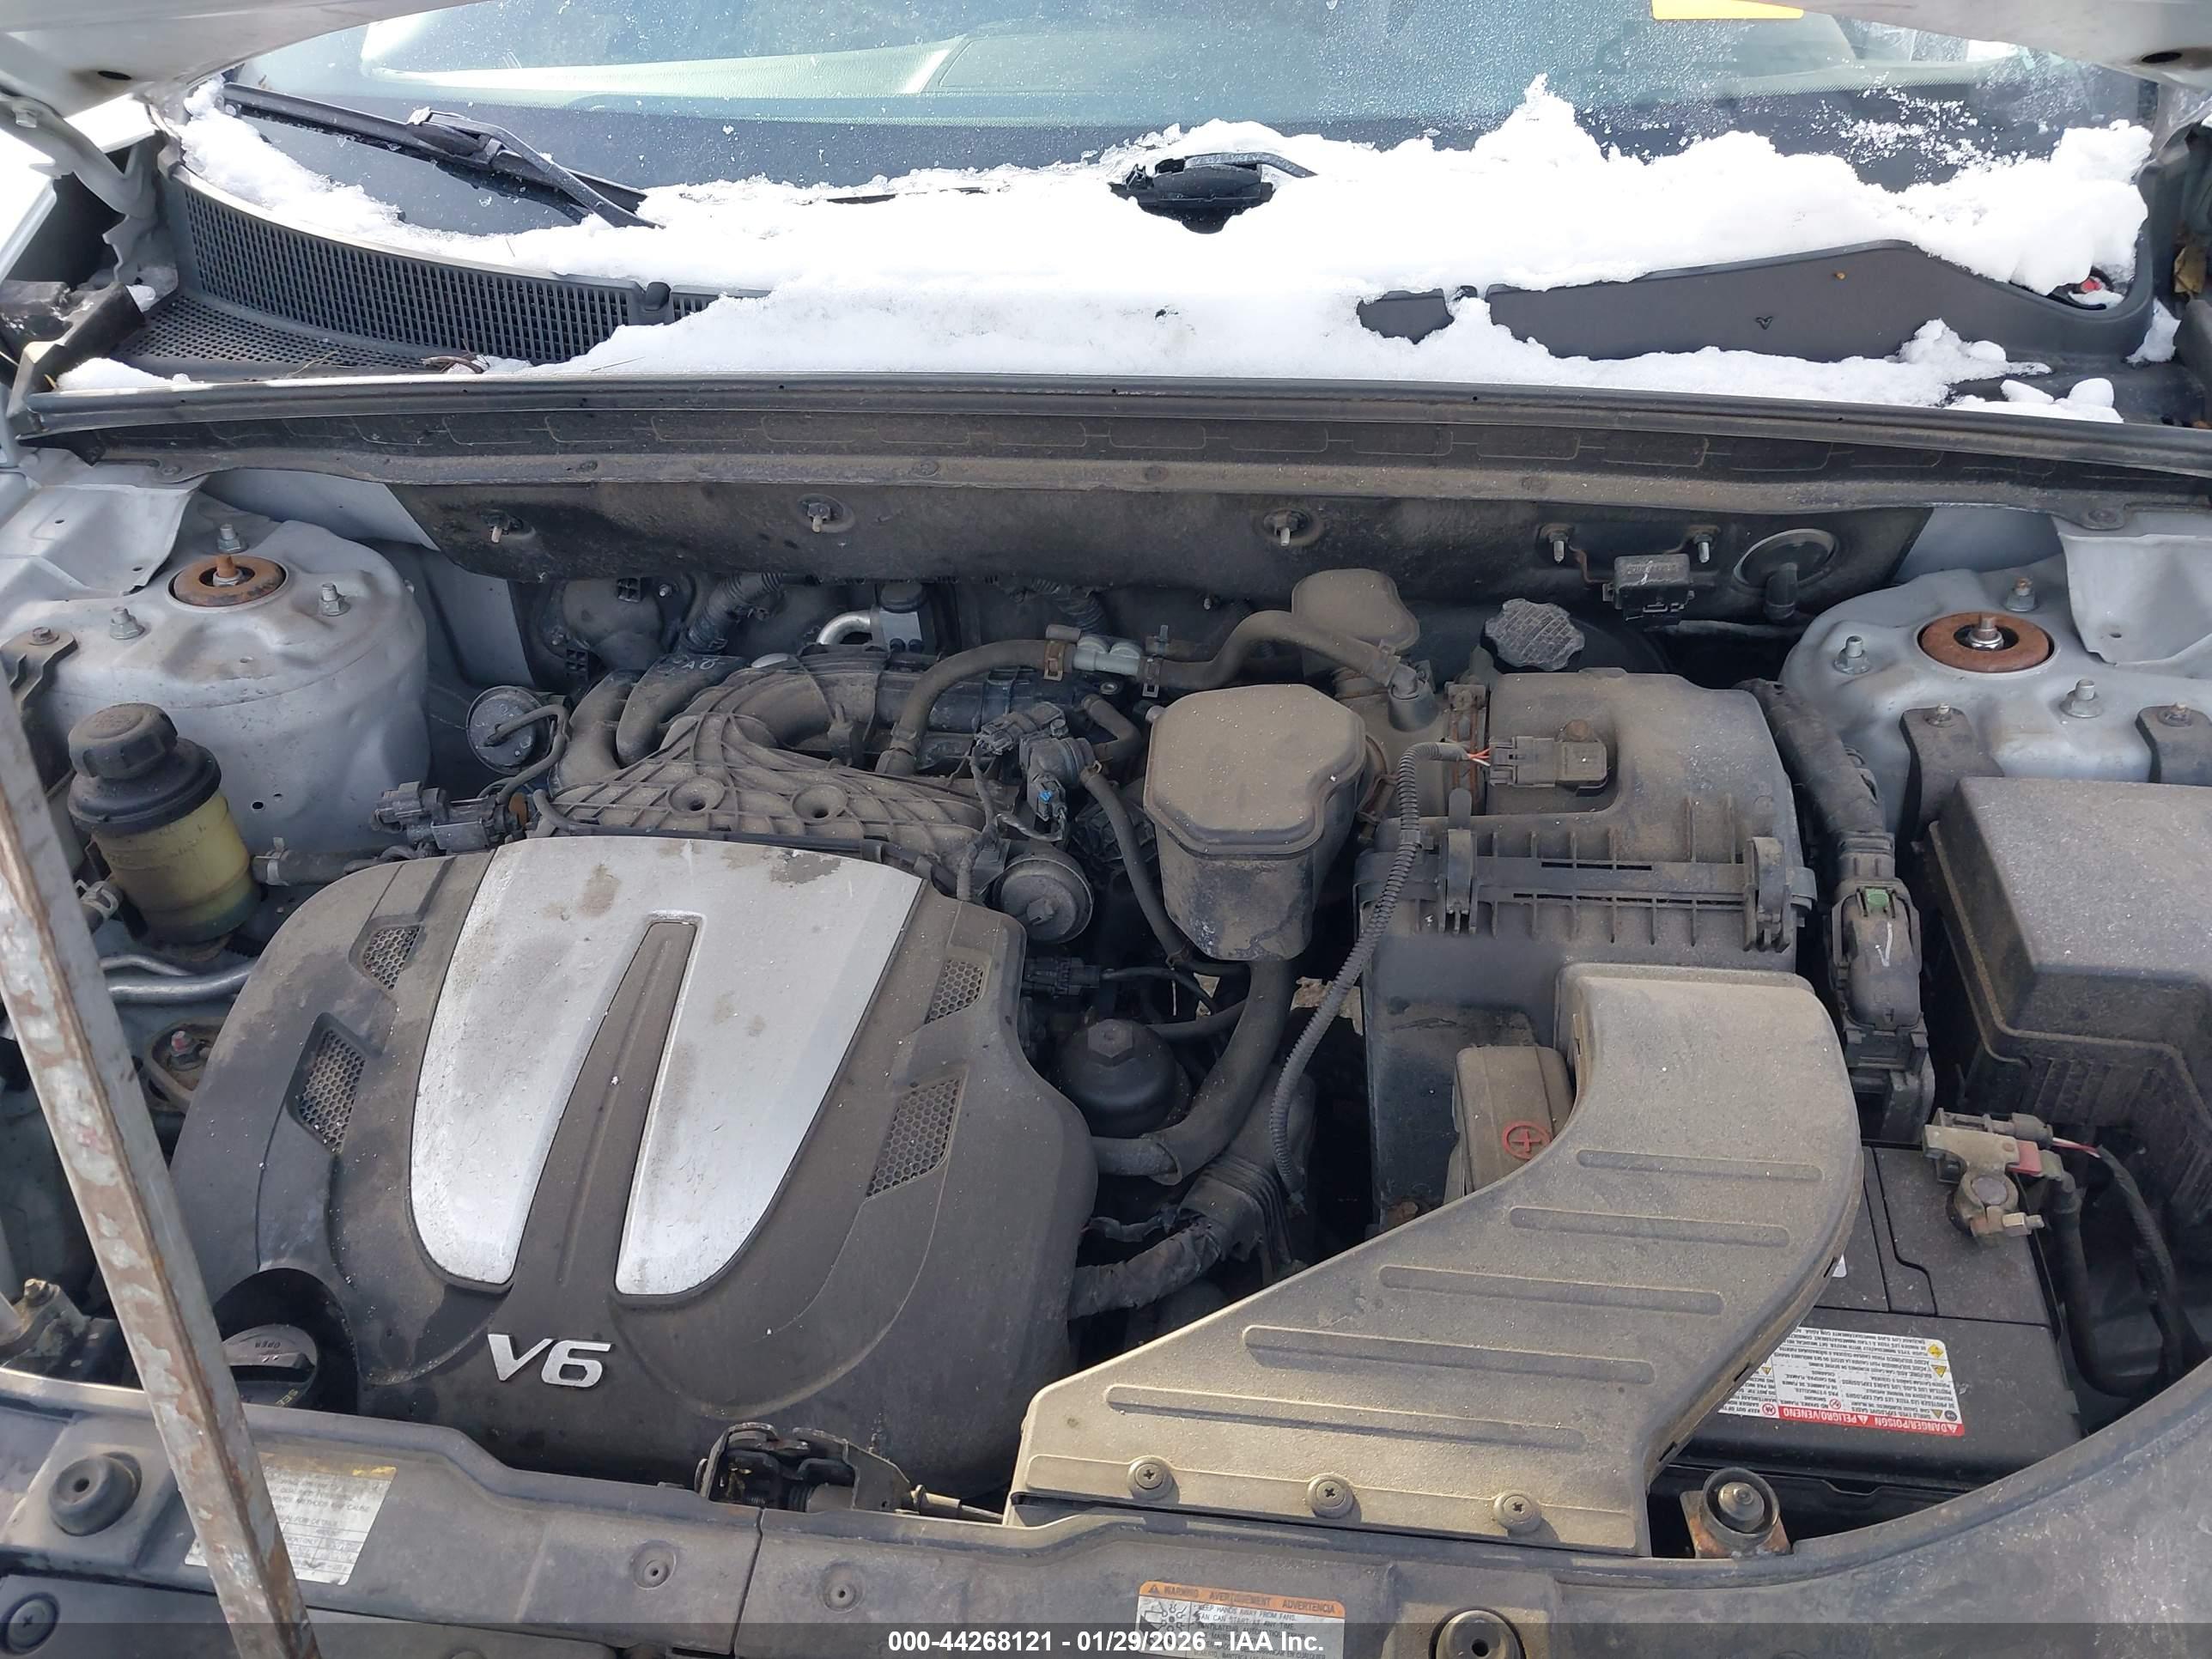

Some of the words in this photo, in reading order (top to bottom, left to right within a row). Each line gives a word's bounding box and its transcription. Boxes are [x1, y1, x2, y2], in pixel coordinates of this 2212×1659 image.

[488, 1334, 611, 1388] V6
[1784, 1409, 1856, 1422] PELIGRO/VENENO
[1875, 1417, 1946, 1431] DANGER/POISON
